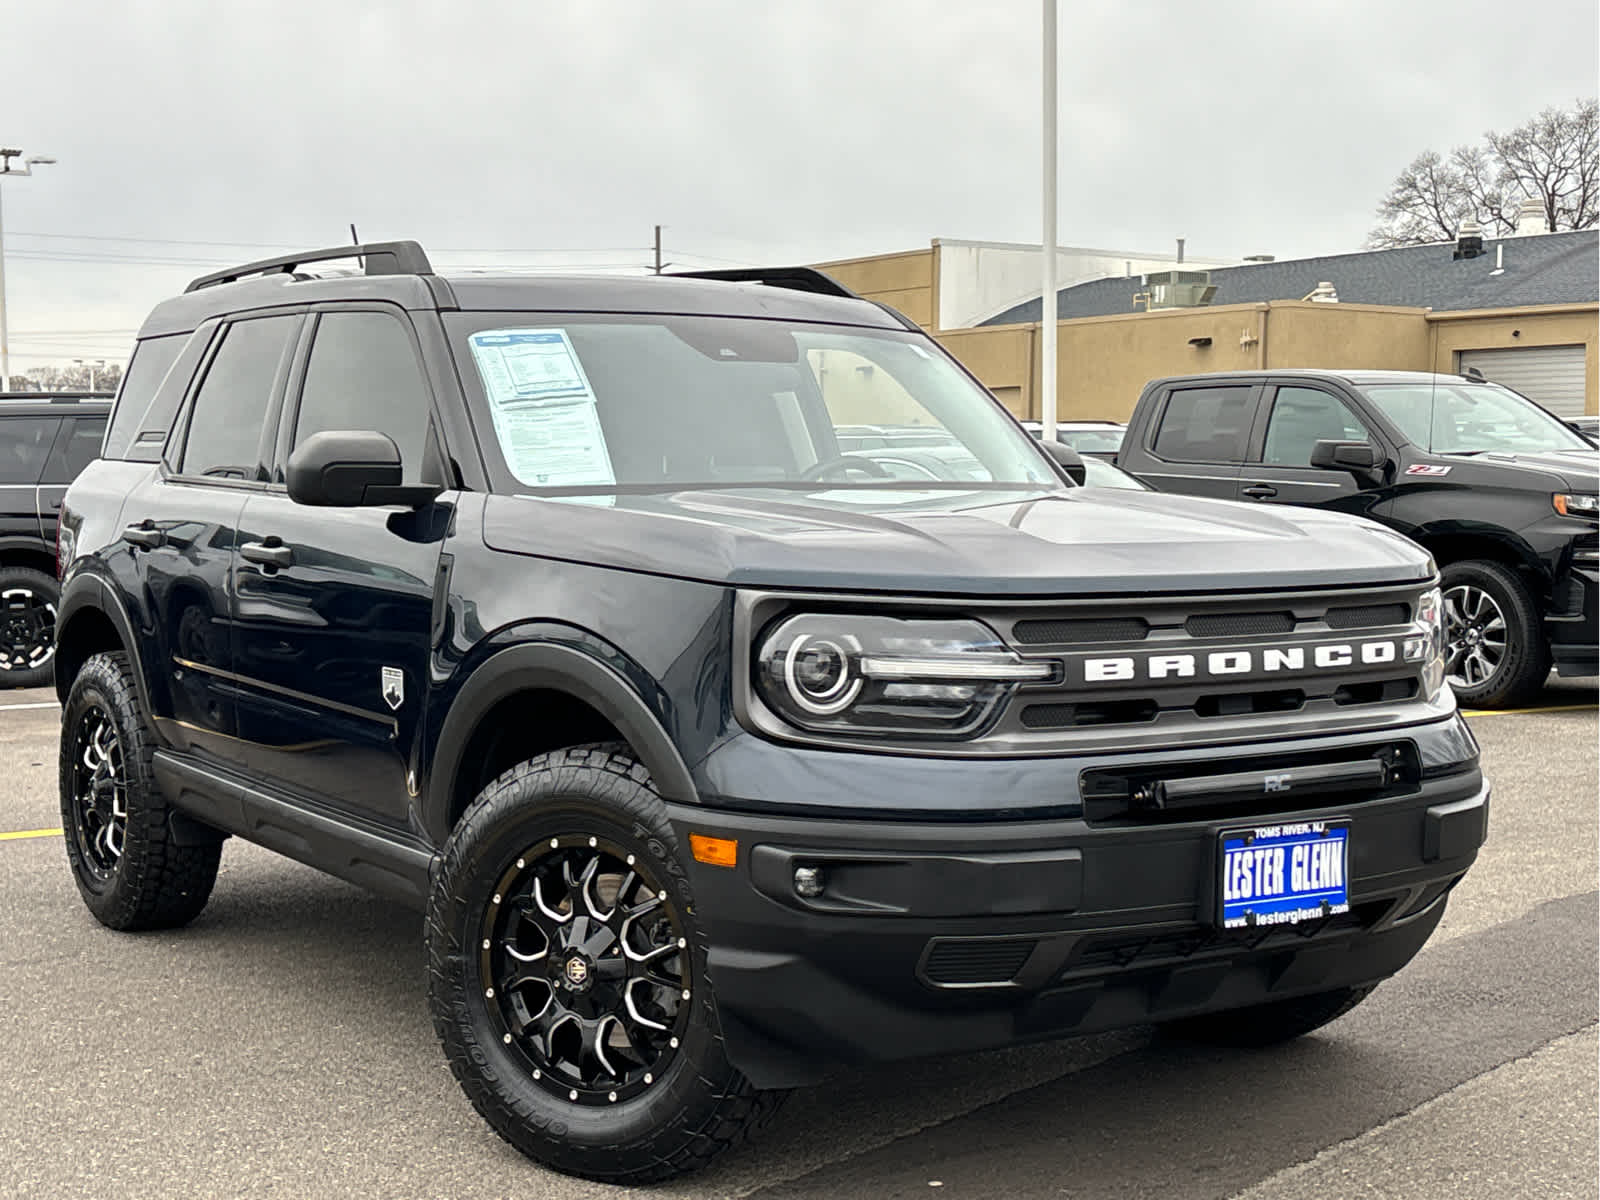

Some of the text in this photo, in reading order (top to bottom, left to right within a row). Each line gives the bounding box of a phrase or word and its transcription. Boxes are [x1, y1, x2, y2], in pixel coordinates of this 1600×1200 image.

[1084, 640, 1396, 681] BRONCO
[1264, 774, 1291, 792] RC
[1254, 828, 1280, 839] TOMS
[1313, 822, 1325, 832] NJ
[1224, 841, 1343, 900] LESTER GLENN
